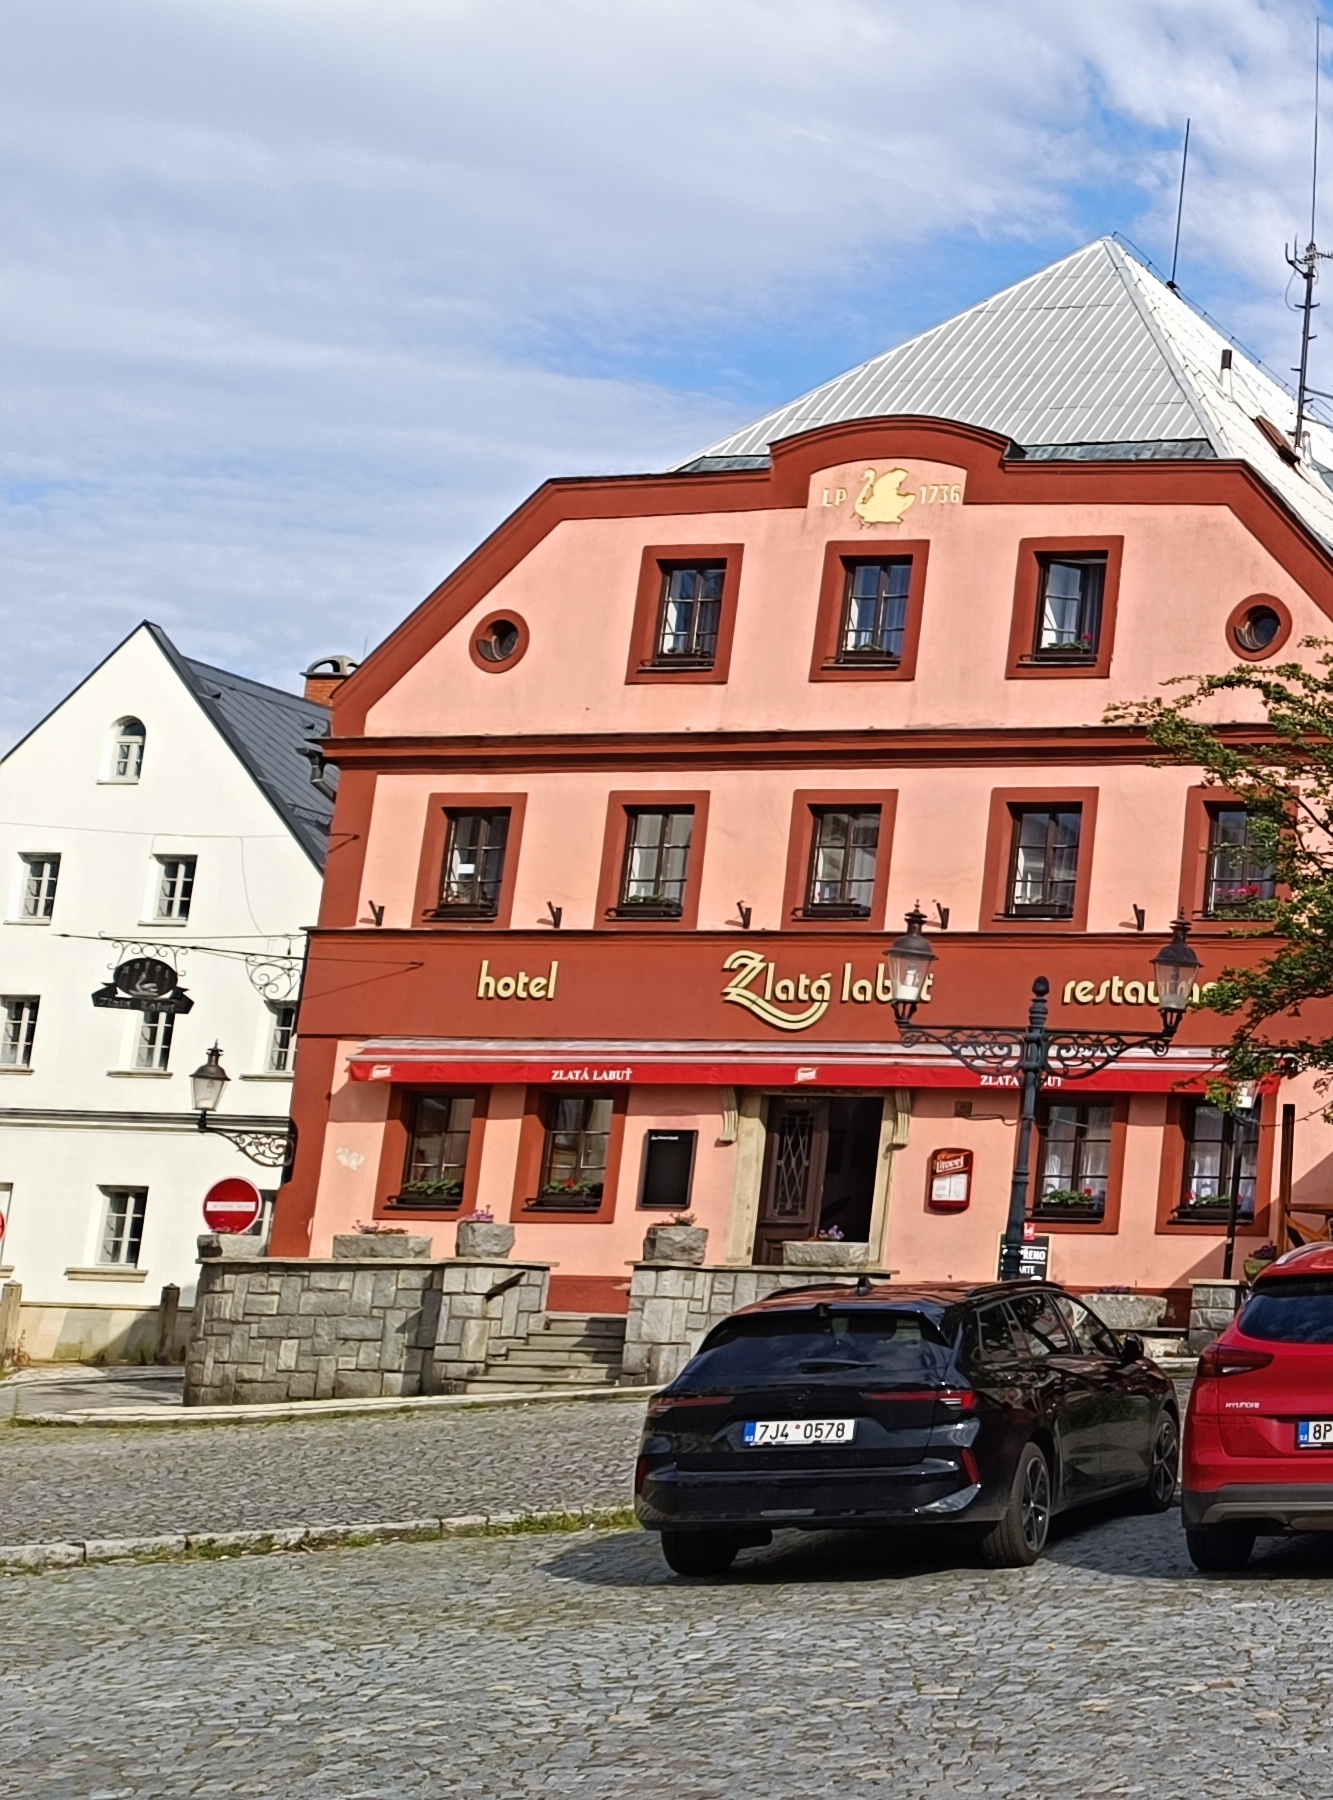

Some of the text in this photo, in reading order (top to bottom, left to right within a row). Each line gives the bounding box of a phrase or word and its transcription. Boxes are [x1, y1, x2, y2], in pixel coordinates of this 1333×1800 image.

[919, 484, 961, 504] 1736
[477, 960, 558, 999] hotel
[722, 950, 934, 1030] Zlatá labť
[551, 1067, 632, 1081] ZLATÁ LABUŤ
[759, 1422, 846, 1440] 7J4 0578
